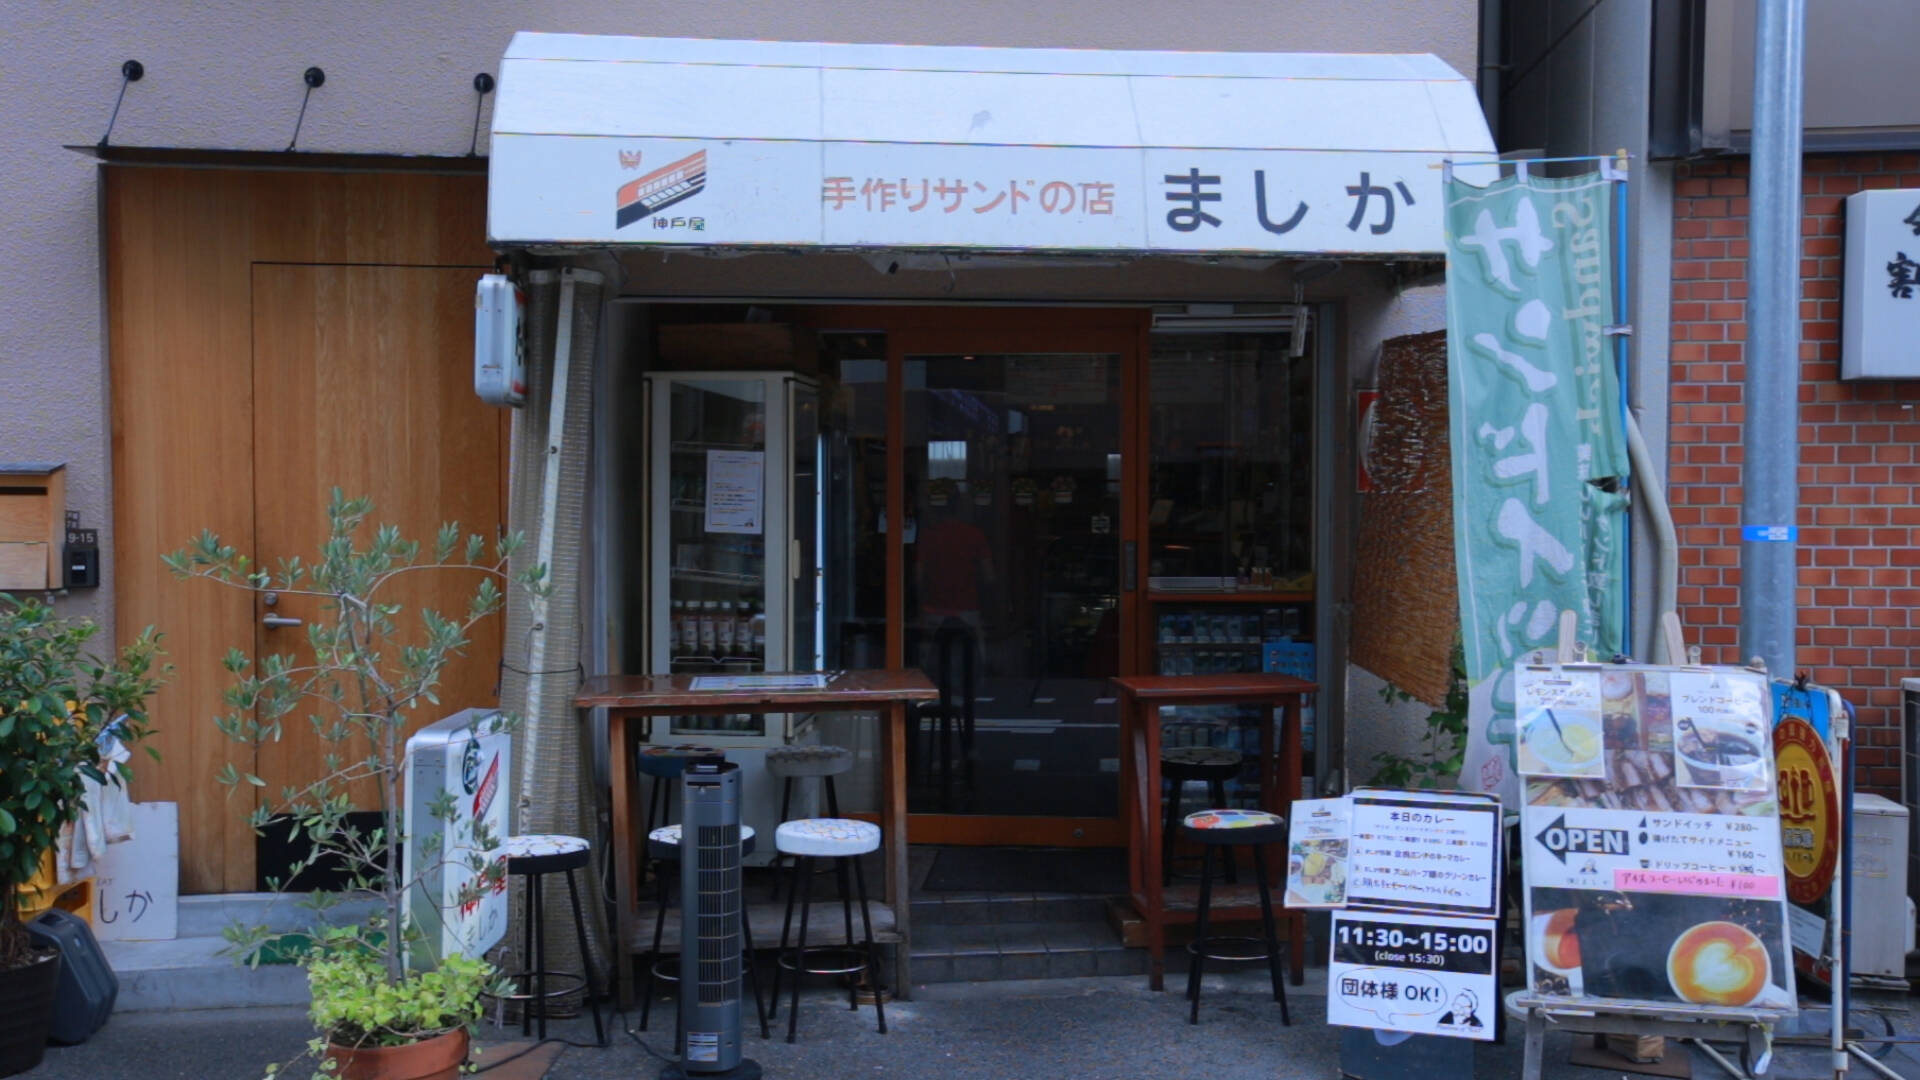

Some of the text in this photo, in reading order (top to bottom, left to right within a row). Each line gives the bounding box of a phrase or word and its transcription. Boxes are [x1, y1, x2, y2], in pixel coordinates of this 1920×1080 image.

[822, 176, 1115, 216] 手作りサンドの店
[1164, 167, 1415, 235] ましか
[68, 533, 94, 544] 9-15
[1389, 811, 1456, 824] 本日のカレー
[1653, 819, 1713, 830] サンドイッチ
[1545, 828, 1624, 854] OPEN
[1655, 860, 1726, 872] ドリップコーヒー
[1374, 950, 1445, 966] (close 15:30)
[1341, 978, 1440, 1003] 団体様 OK!
